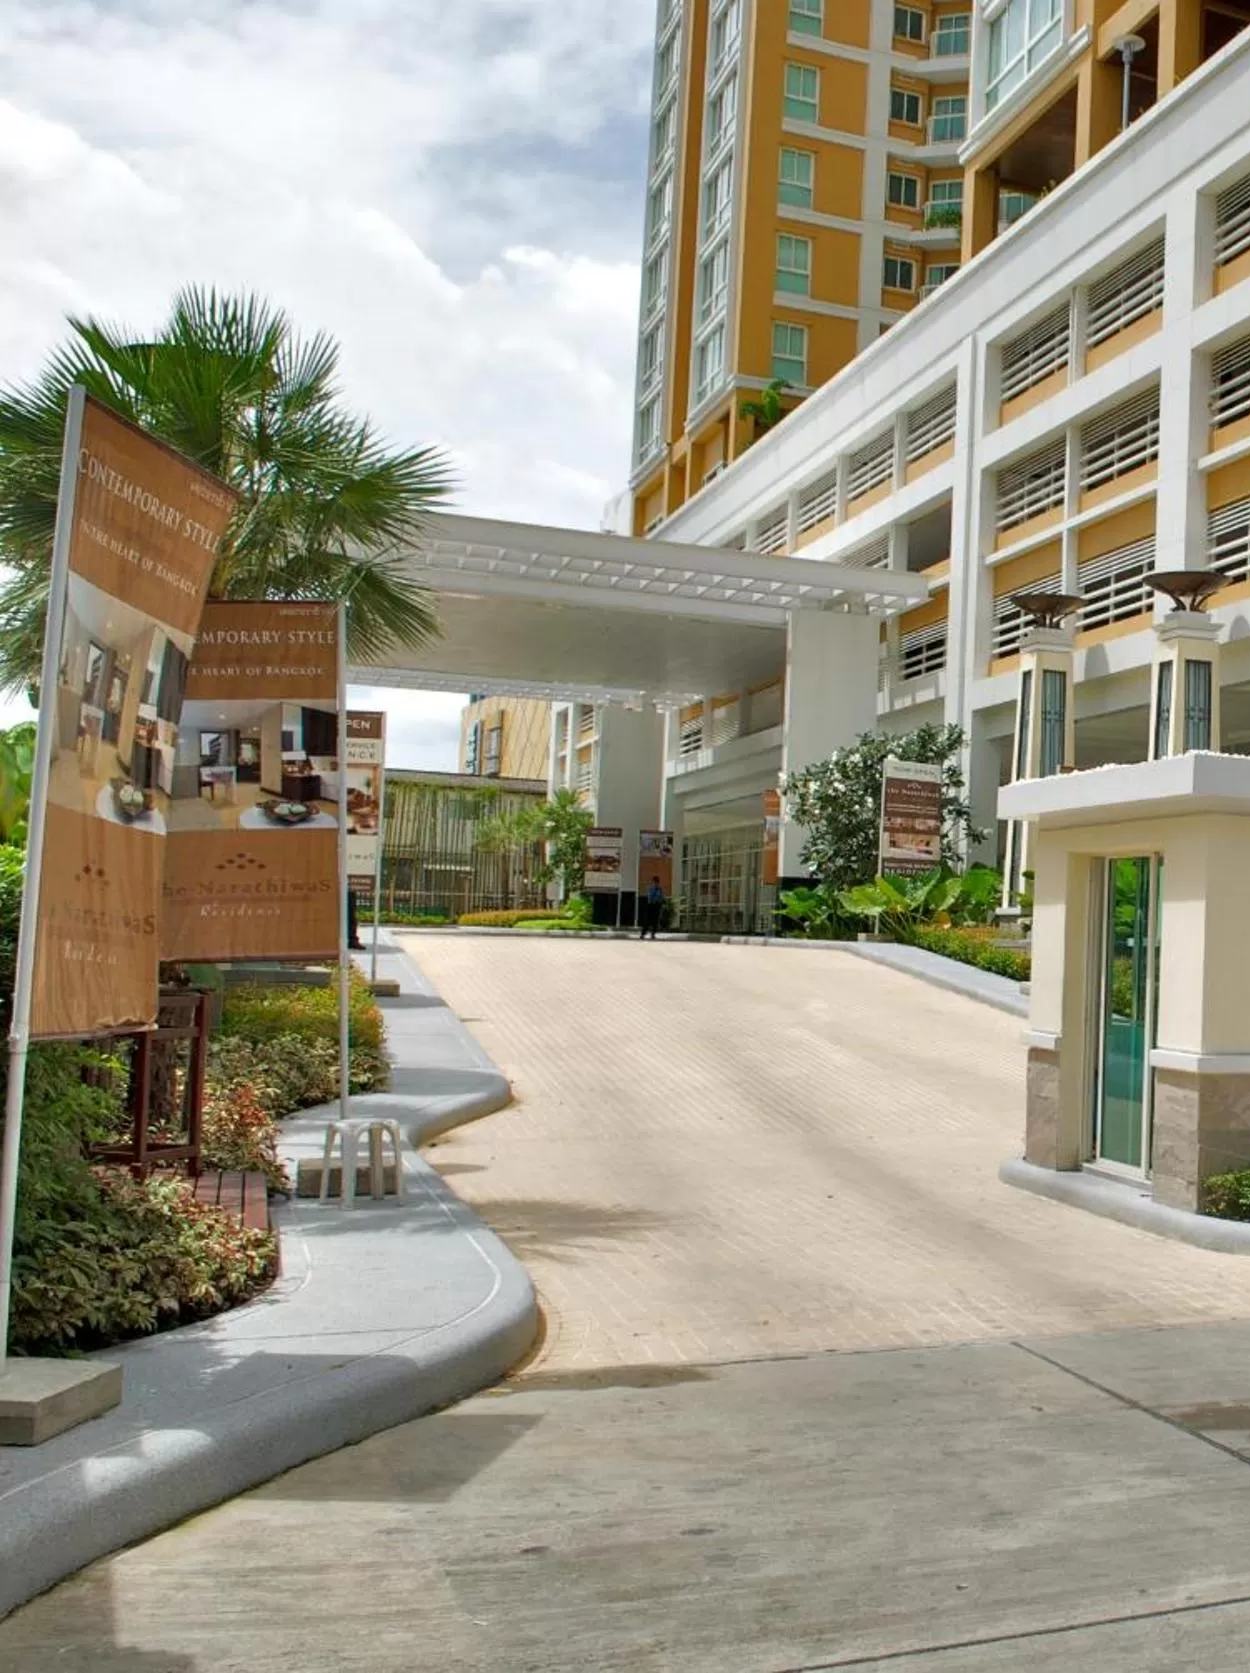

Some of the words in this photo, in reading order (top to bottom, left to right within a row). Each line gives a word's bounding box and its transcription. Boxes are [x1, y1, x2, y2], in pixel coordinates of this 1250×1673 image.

[78, 448, 184, 532] CONTEMPORARY
[195, 629, 281, 645] MPORARY
[287, 630, 336, 645] STYLE
[345, 719, 371, 729] PEN
